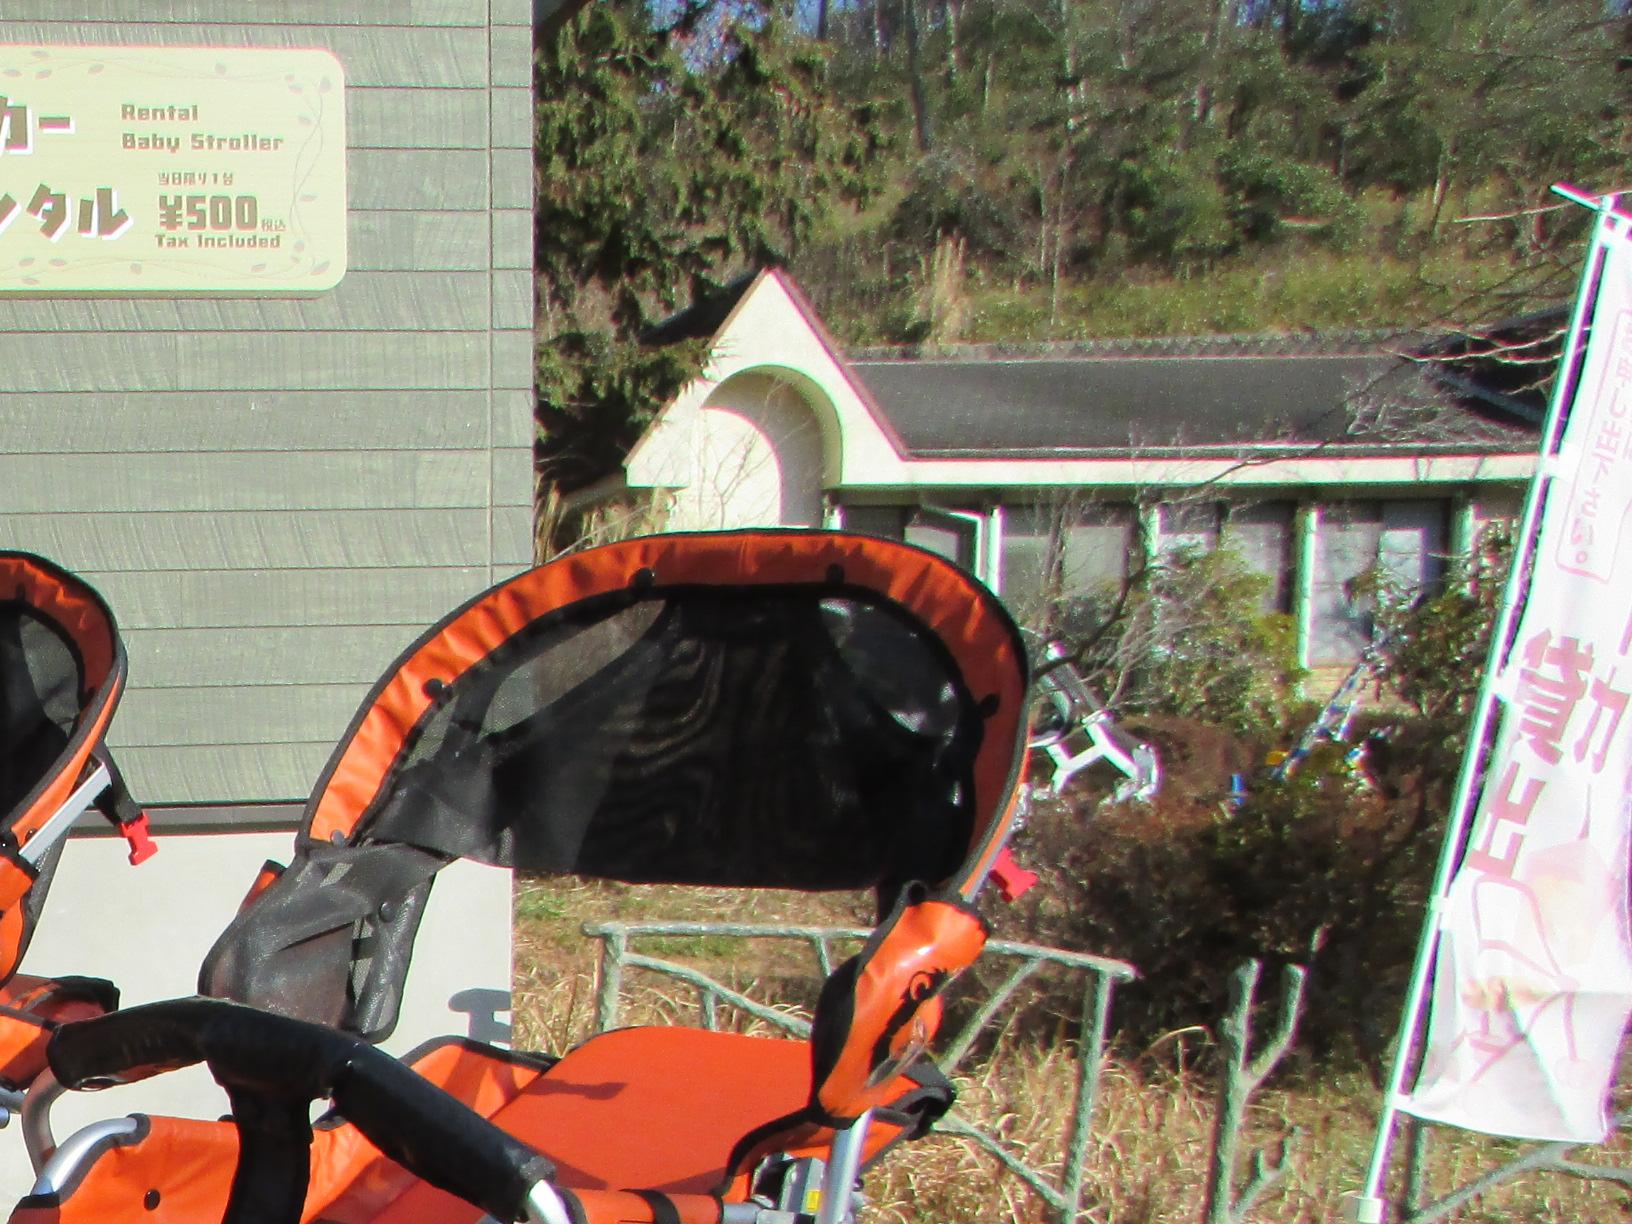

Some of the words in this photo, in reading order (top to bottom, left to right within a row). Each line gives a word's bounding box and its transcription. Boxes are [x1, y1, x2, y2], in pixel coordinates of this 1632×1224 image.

[121, 104, 199, 121] Rental
[122, 133, 179, 153] Baby
[190, 132, 285, 152] Stroller
[159, 195, 258, 232] ¥500
[154, 234, 189, 248] Tax
[197, 234, 281, 249] Included
